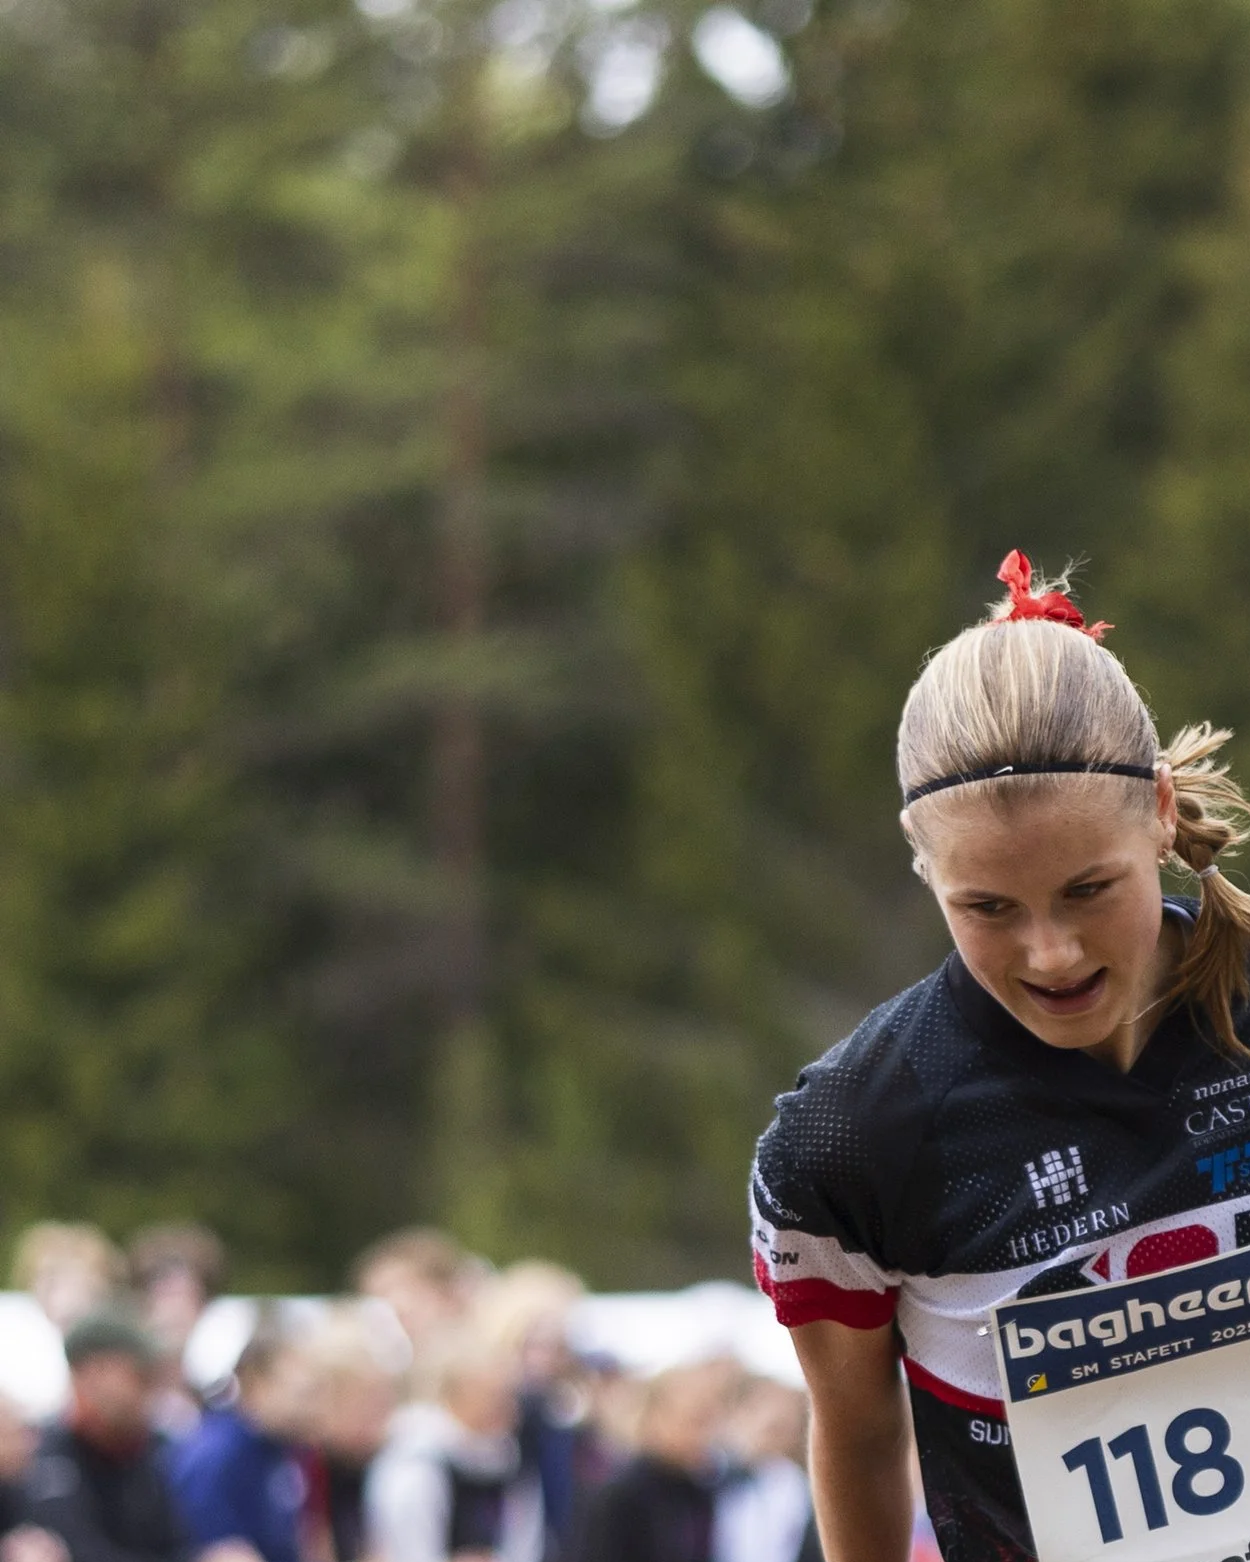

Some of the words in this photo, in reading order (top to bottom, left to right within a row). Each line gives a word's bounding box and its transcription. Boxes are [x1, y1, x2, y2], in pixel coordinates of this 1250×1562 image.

[1010, 1202, 1131, 1260] HEDERN
[1071, 1362, 1100, 1380] SM
[1110, 1337, 1195, 1370] STAFETT
[1061, 1407, 1245, 1544] 118
